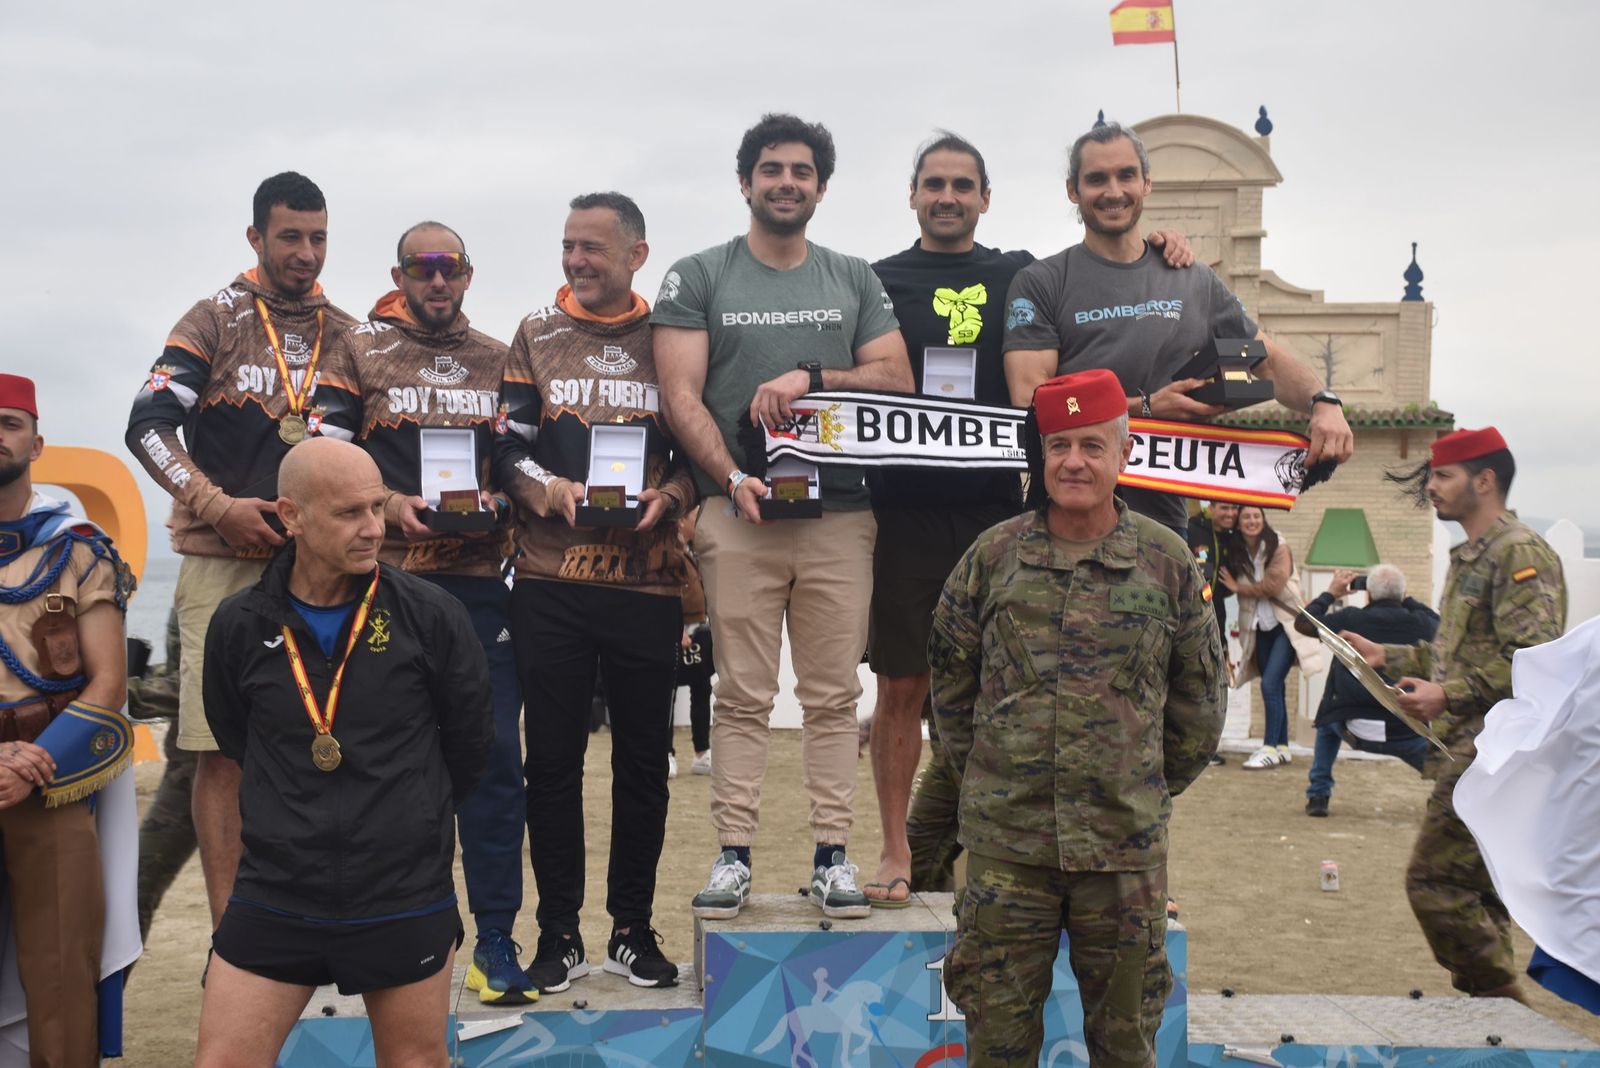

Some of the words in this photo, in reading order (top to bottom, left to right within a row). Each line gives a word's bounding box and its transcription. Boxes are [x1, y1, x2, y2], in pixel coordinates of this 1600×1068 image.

[722, 309, 843, 326] BOMBEROS
[1075, 300, 1182, 324] BOMBEROS
[237, 364, 277, 396] SOY
[388, 386, 432, 414] SOY
[550, 378, 595, 406] SOY
[598, 380, 659, 413] FUERT
[1127, 433, 1246, 479] CEUTA
[683, 653, 702, 665] US
